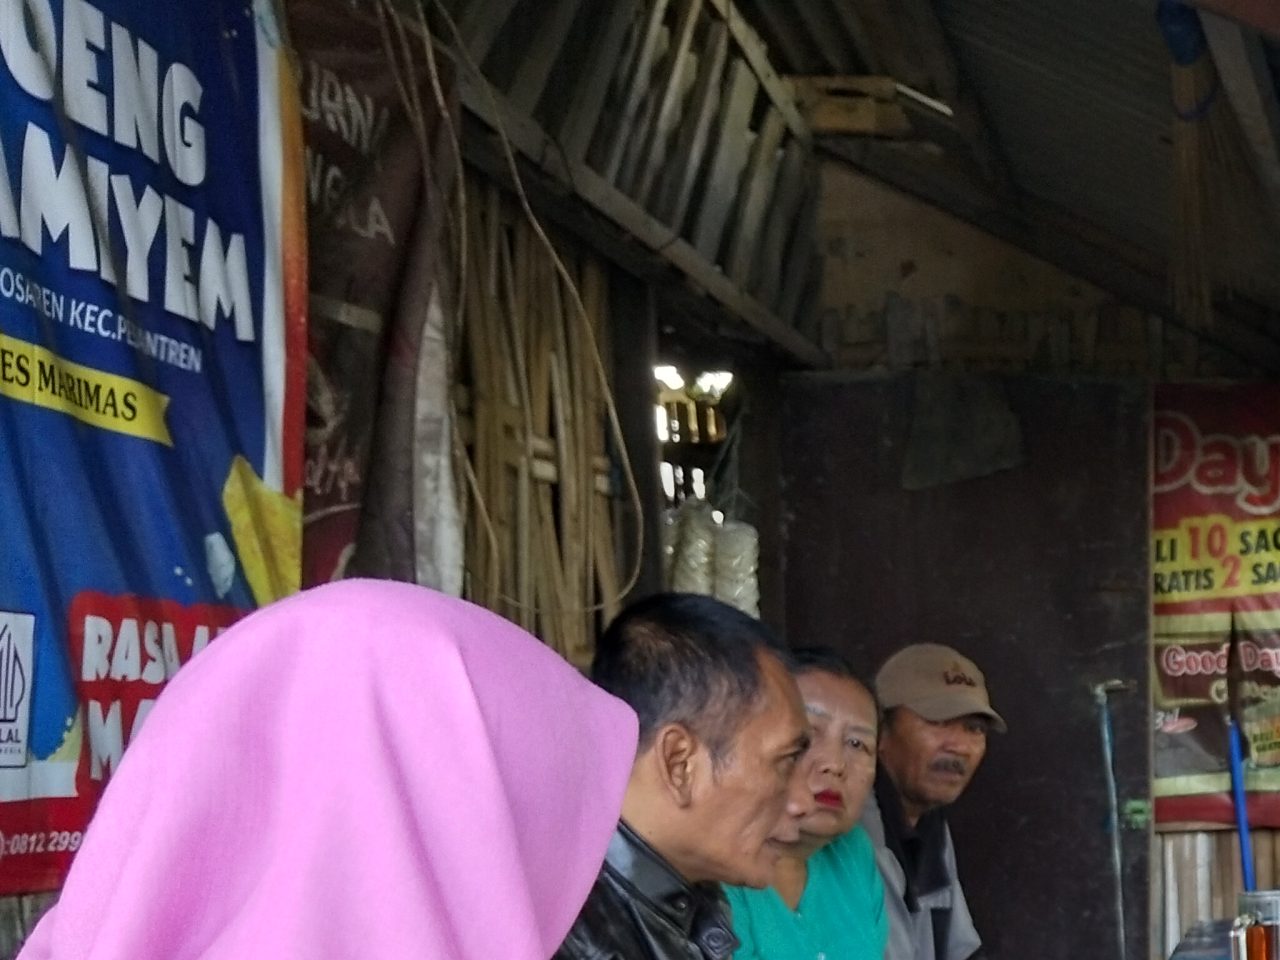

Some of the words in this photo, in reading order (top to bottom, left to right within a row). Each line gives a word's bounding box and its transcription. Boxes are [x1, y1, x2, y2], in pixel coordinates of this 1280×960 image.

[37, 360, 138, 422] MARIMAS
[1188, 523, 1228, 560] 10
[1221, 555, 1242, 588] 2
